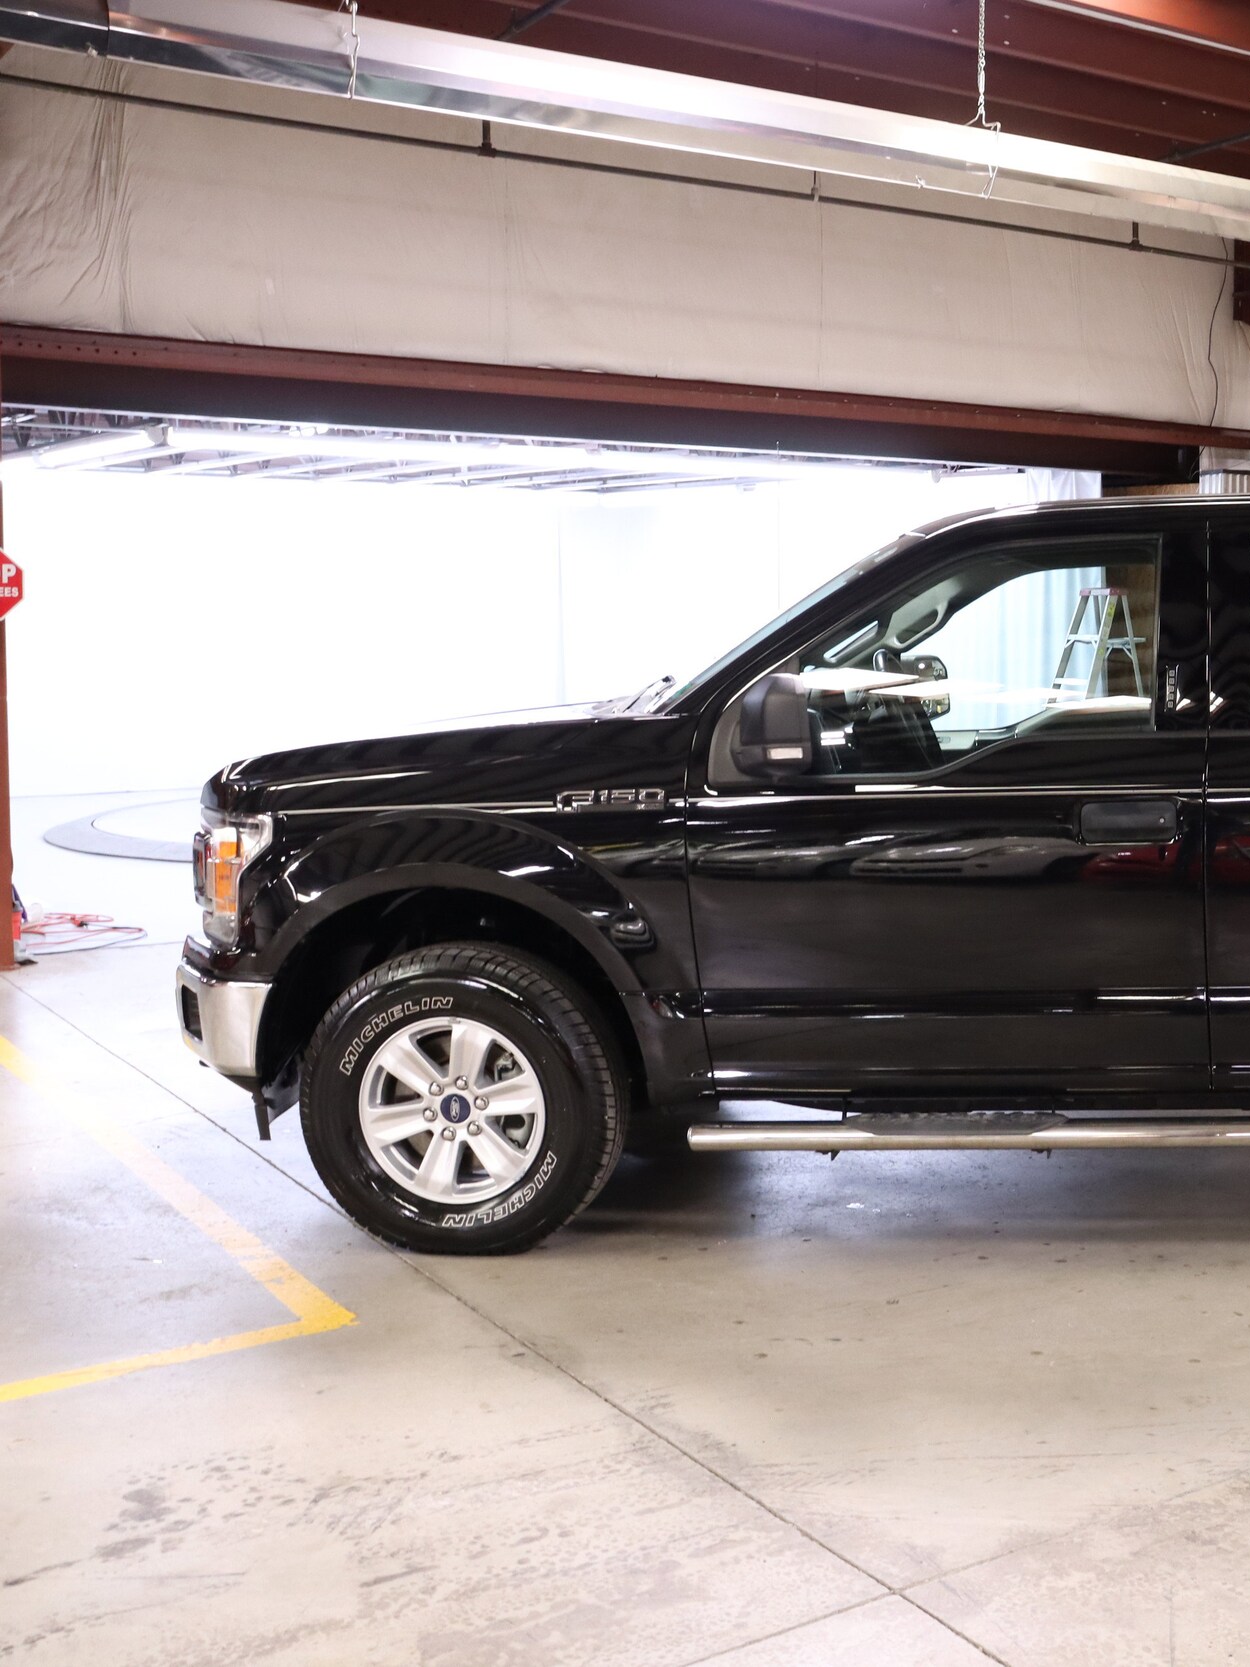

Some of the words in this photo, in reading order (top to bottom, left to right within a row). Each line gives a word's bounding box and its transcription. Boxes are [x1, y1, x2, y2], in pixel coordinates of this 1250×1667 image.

[0, 563, 17, 583] P
[340, 996, 453, 1076] MICHELIN
[442, 1151, 558, 1228] MICHELIN
